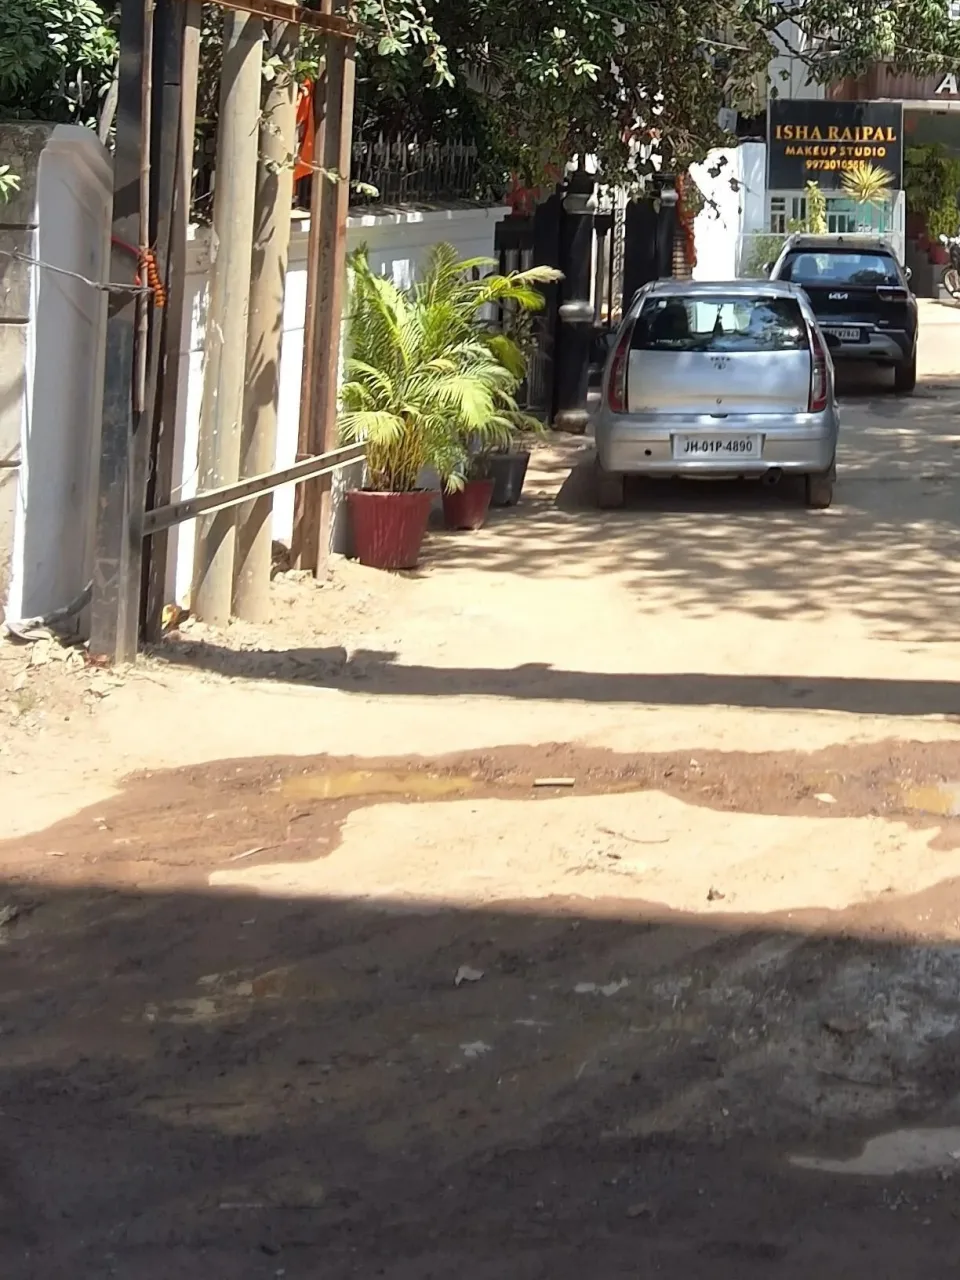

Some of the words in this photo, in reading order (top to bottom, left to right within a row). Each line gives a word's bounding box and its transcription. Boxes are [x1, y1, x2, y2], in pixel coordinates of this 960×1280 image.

[775, 124, 822, 140] ISHA
[828, 125, 897, 142] RAJPAL
[785, 146, 837, 157] MAKEUP
[840, 146, 886, 157] STUDIO
